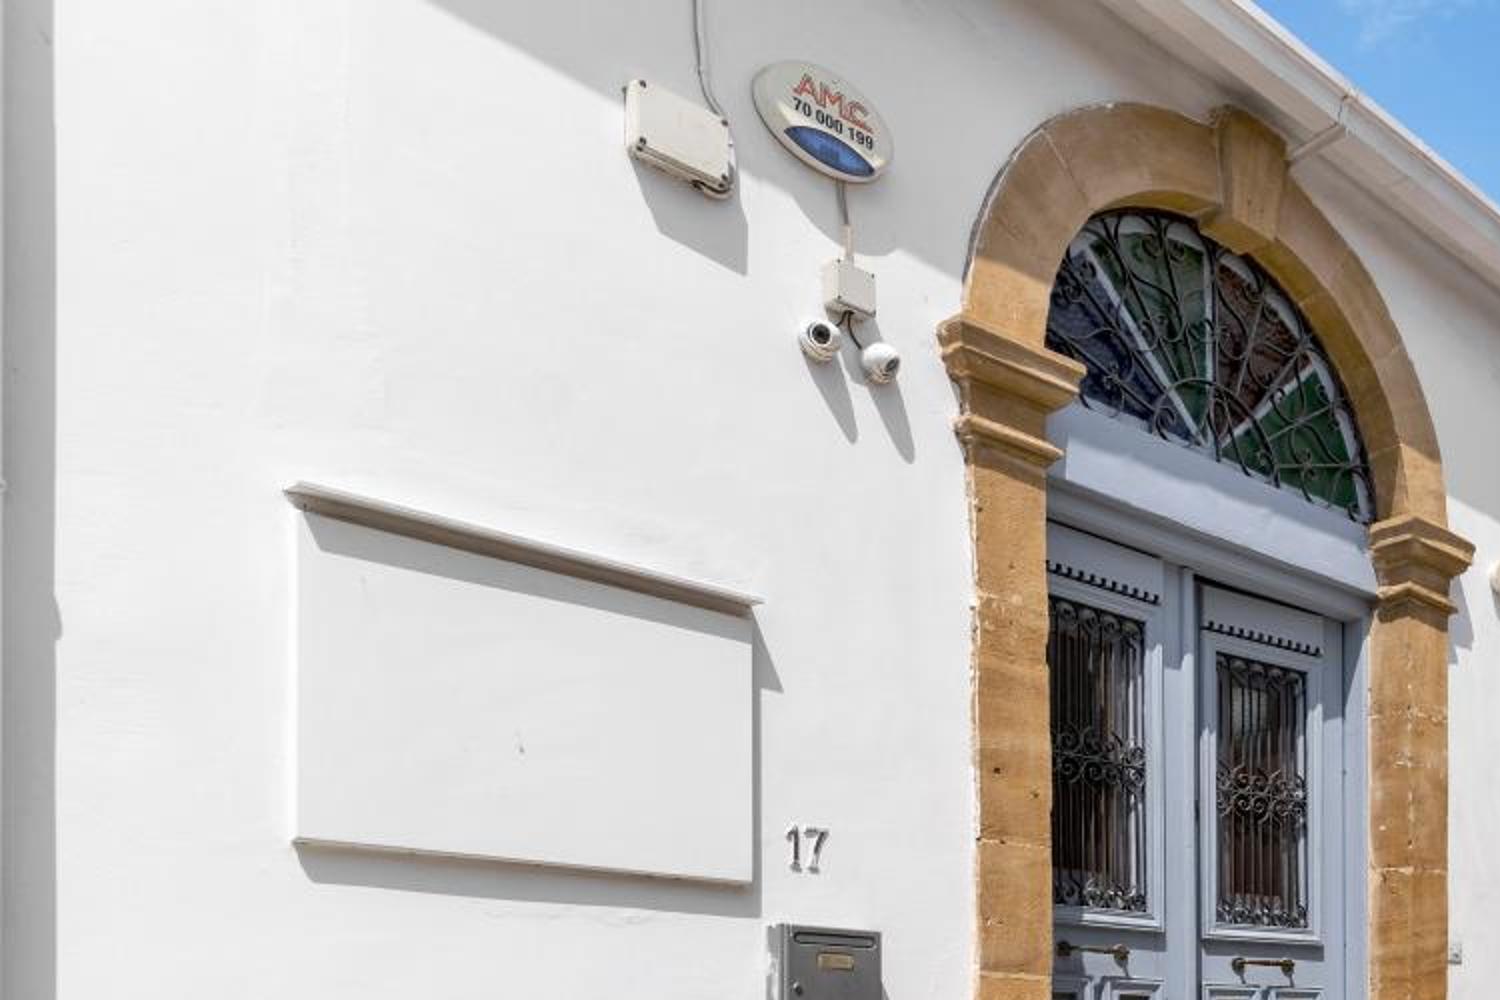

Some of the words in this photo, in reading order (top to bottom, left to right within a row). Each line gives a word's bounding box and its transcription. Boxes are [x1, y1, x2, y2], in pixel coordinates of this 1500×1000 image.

[793, 73, 874, 134] AMC
[793, 96, 811, 117] 70
[816, 109, 843, 134] 000
[847, 127, 873, 150] 199
[786, 825, 829, 874] 17
